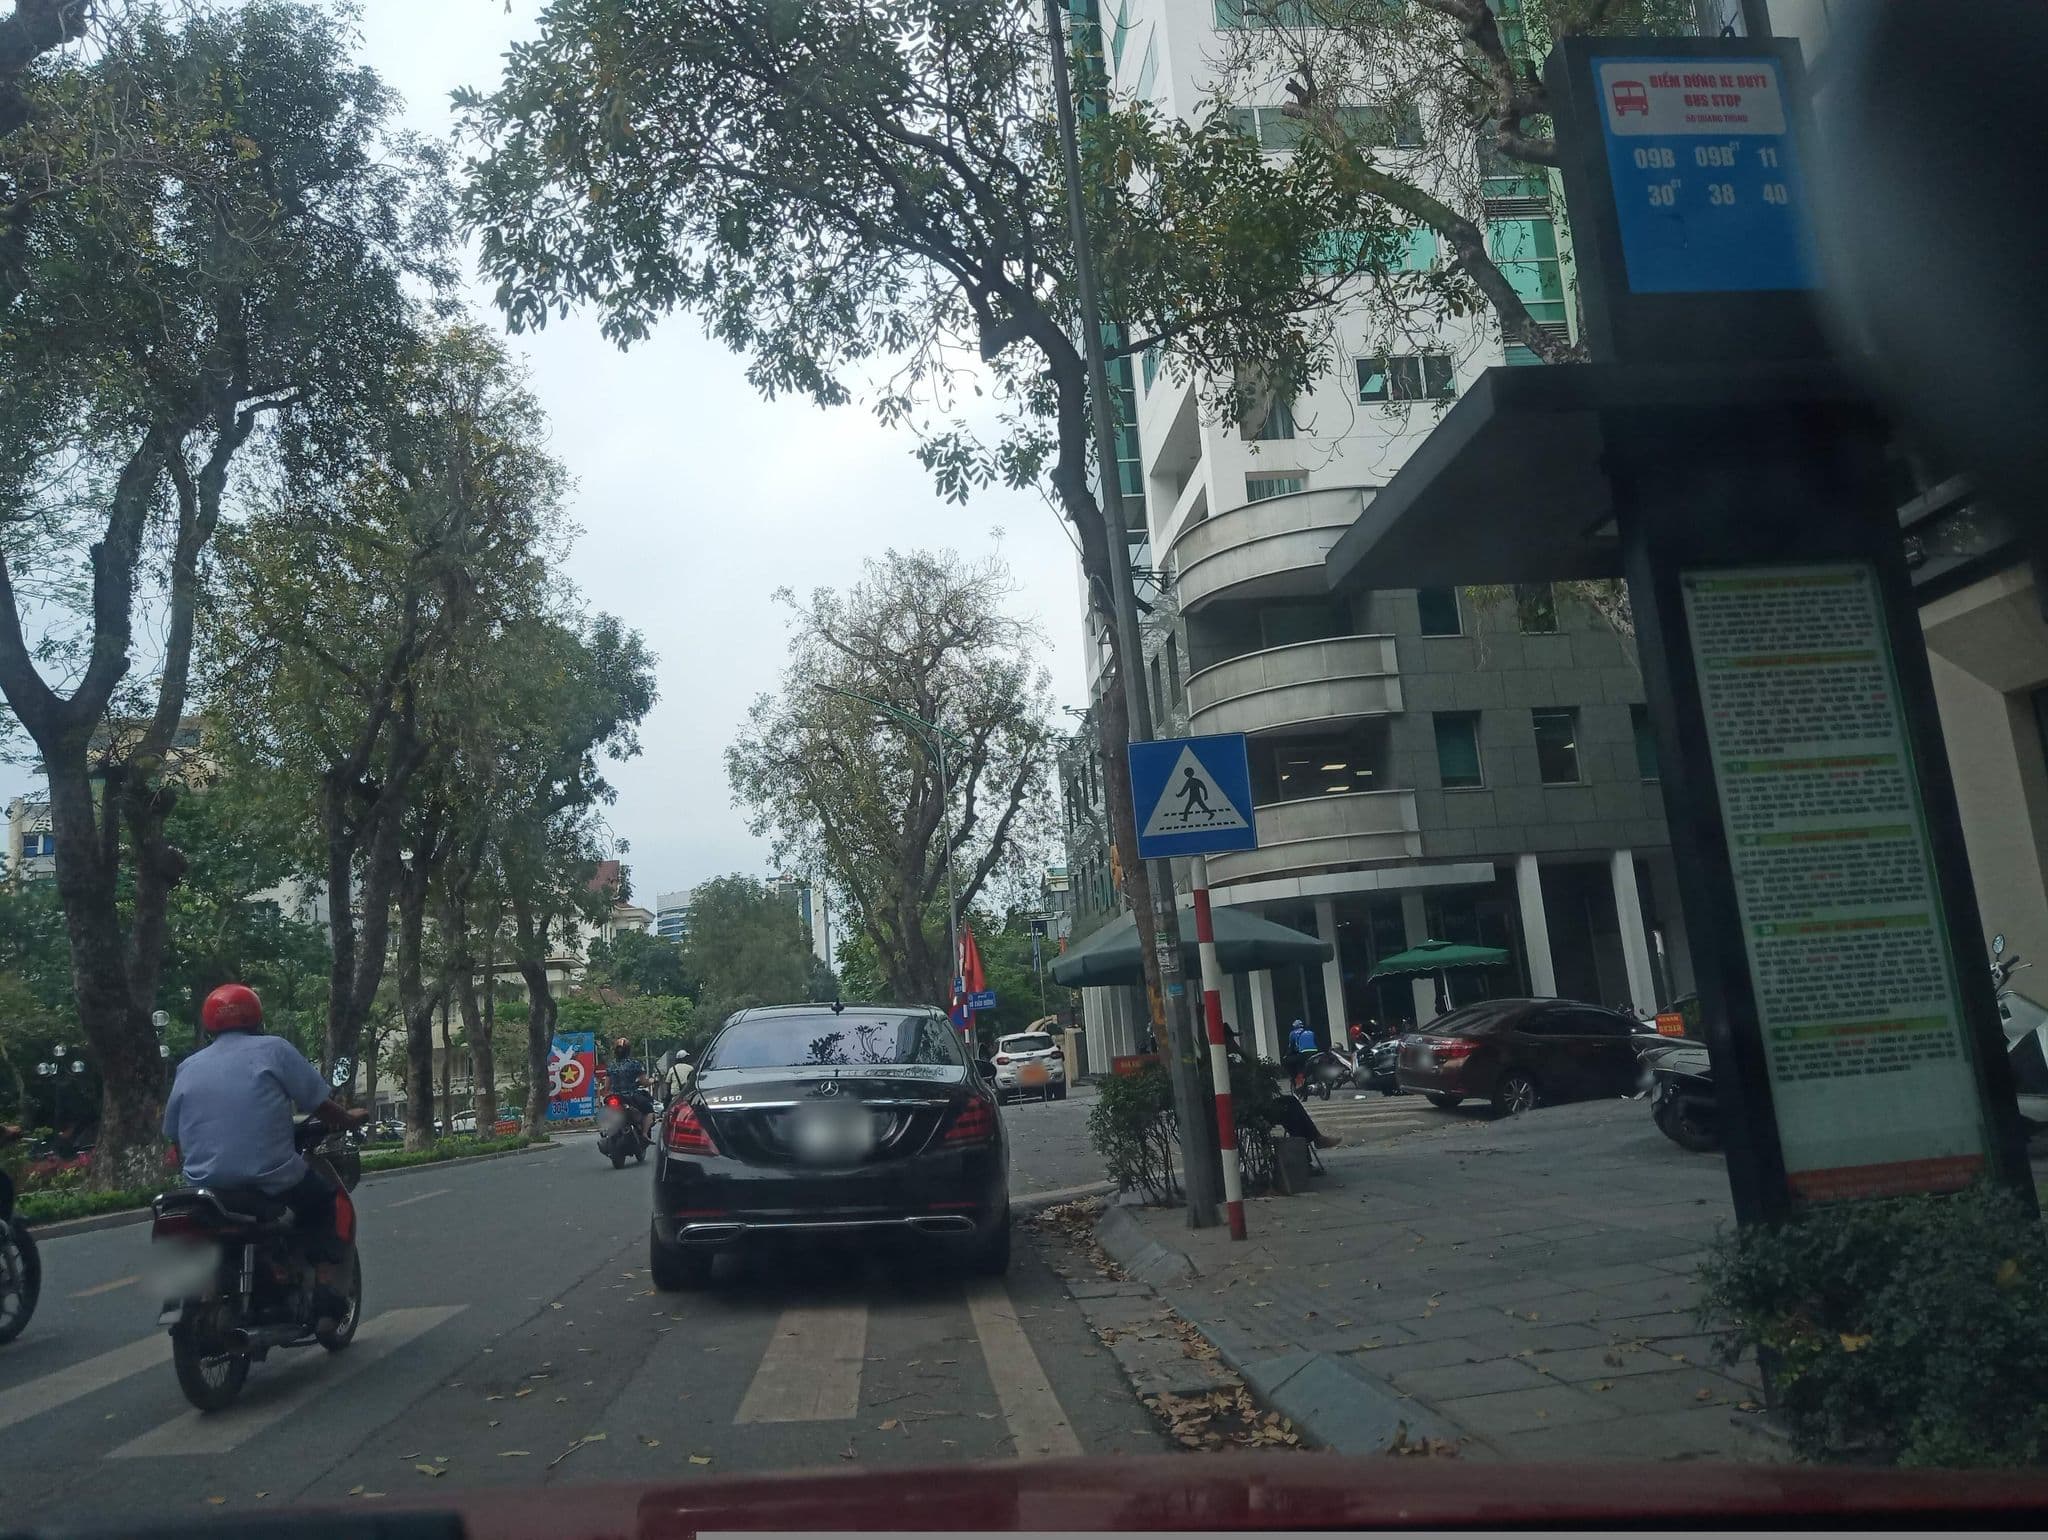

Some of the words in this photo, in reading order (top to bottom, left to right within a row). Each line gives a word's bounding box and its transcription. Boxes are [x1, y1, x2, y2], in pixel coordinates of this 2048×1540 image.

[1719, 75, 1734, 89] XE
[1684, 94, 1709, 107] BUS
[1711, 94, 1741, 107] STOP
[1634, 147, 1675, 168] 09B
[1759, 148, 1777, 168] 11
[1708, 183, 1735, 205] 38
[1763, 183, 1788, 205] 40
